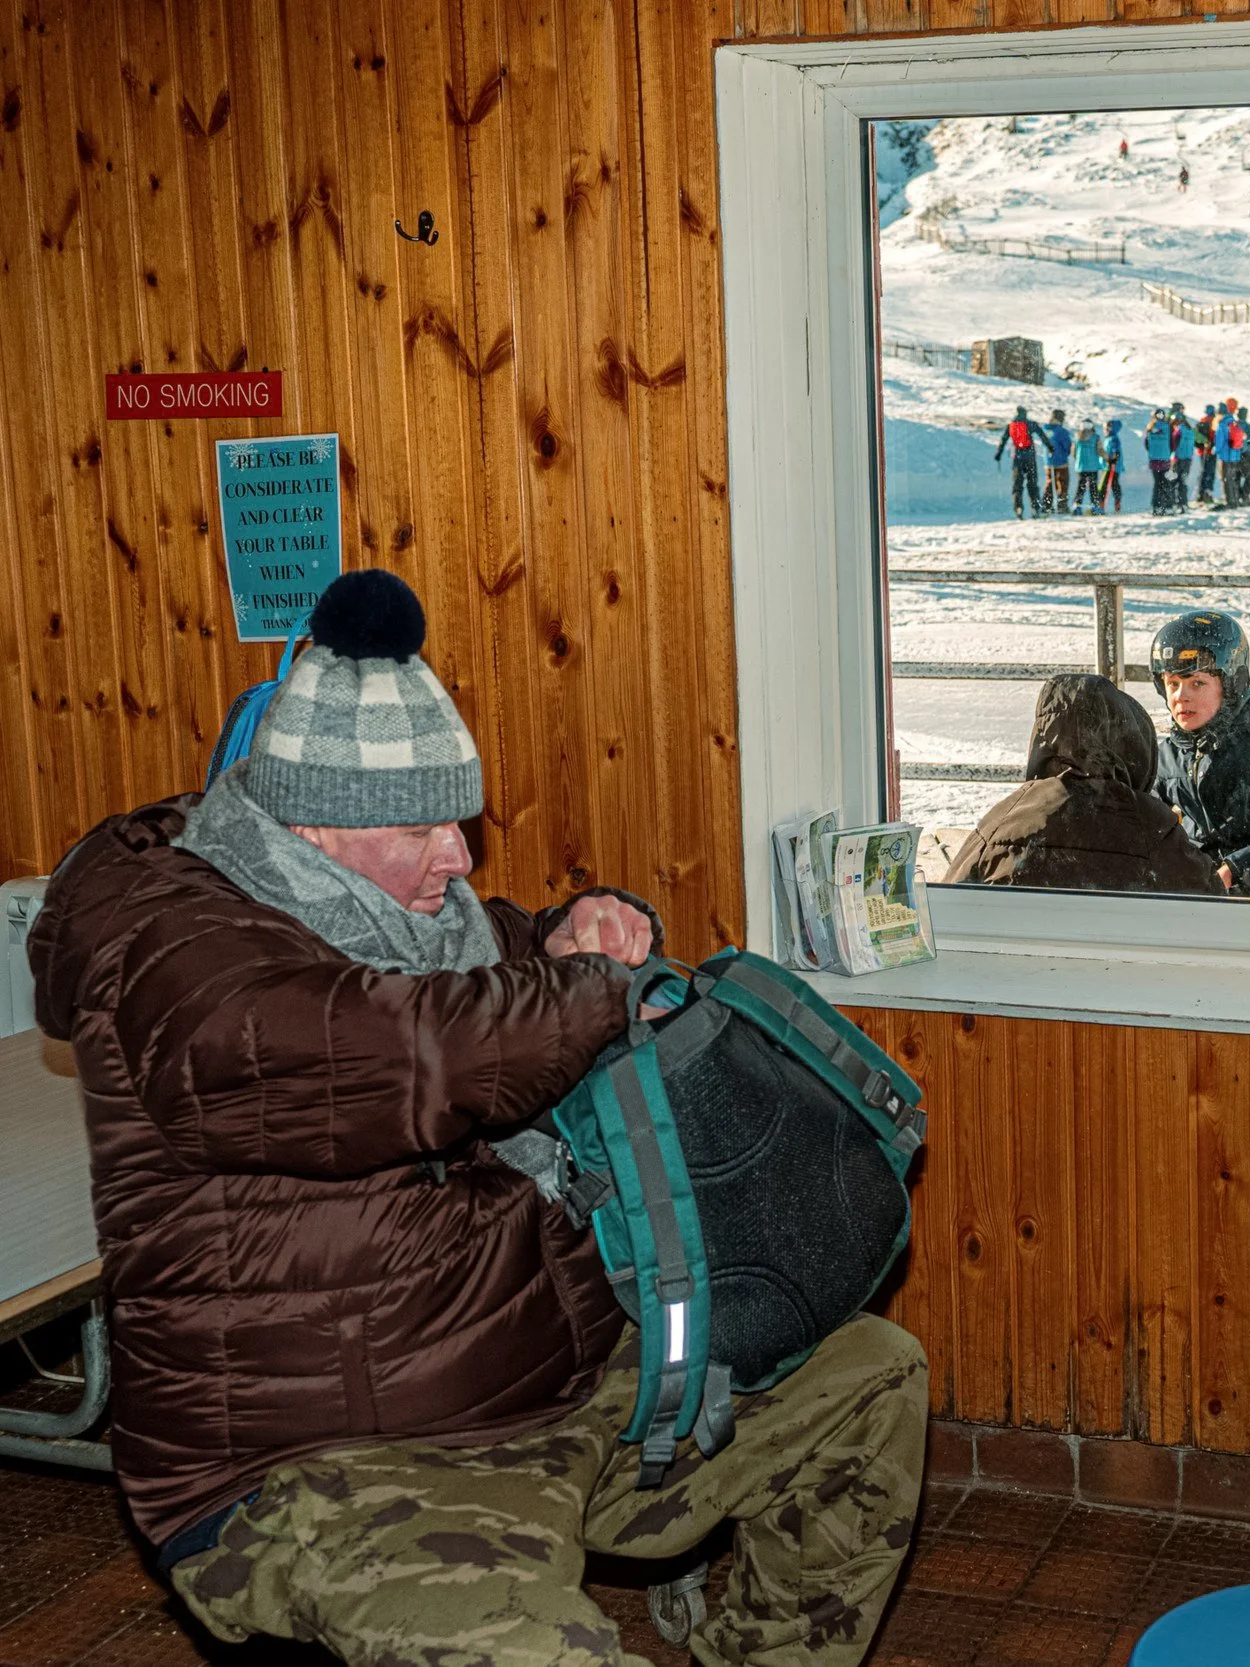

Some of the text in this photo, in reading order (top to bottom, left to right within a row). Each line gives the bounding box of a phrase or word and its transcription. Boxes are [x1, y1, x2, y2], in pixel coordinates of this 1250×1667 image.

[117, 381, 270, 409] NO SMOKING
[237, 449, 319, 469] PLEASE BE
[225, 477, 334, 499] CONSIDERATE
[238, 506, 325, 526] AND CLEAR
[235, 535, 329, 554] YOUR TABLE
[260, 563, 305, 580] WHEN
[252, 591, 319, 610] FINISHED
[261, 618, 292, 629] THANK
